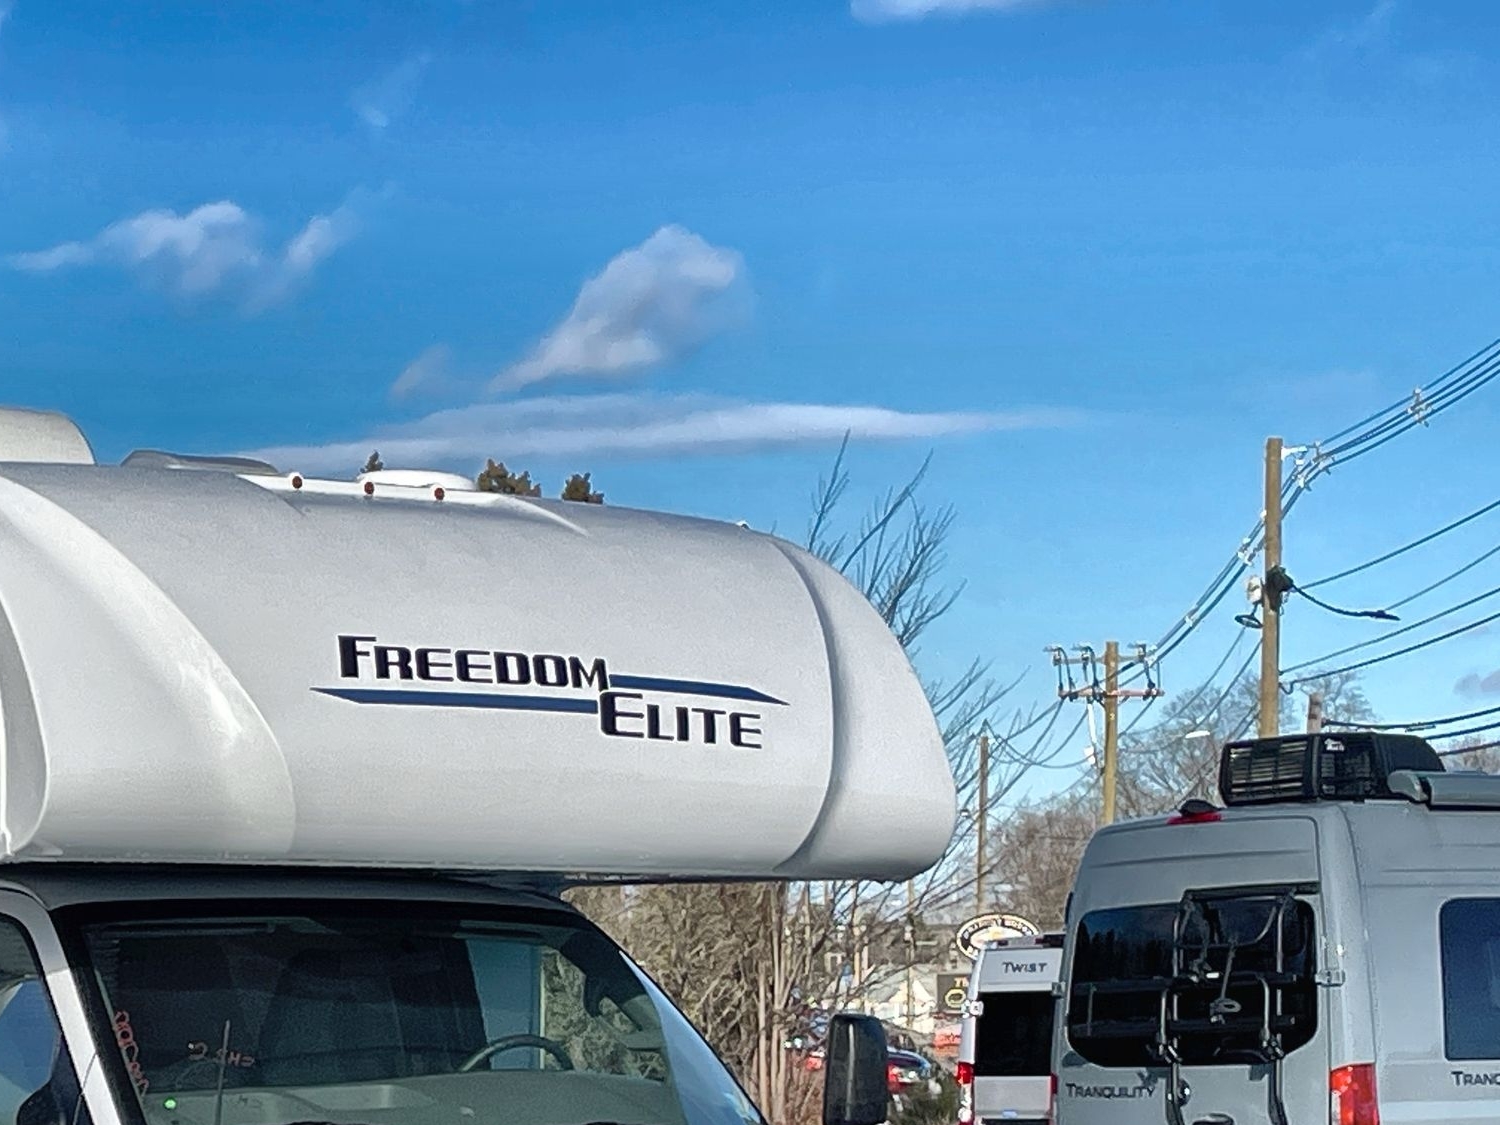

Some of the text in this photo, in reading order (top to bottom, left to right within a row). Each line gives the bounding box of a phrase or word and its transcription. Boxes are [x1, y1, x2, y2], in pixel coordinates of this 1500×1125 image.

[337, 634, 608, 691] FREEDOM
[600, 691, 763, 749] ELITE
[1002, 961, 1048, 973] TWIST
[1065, 1082, 1156, 1099] TRANQUILITY
